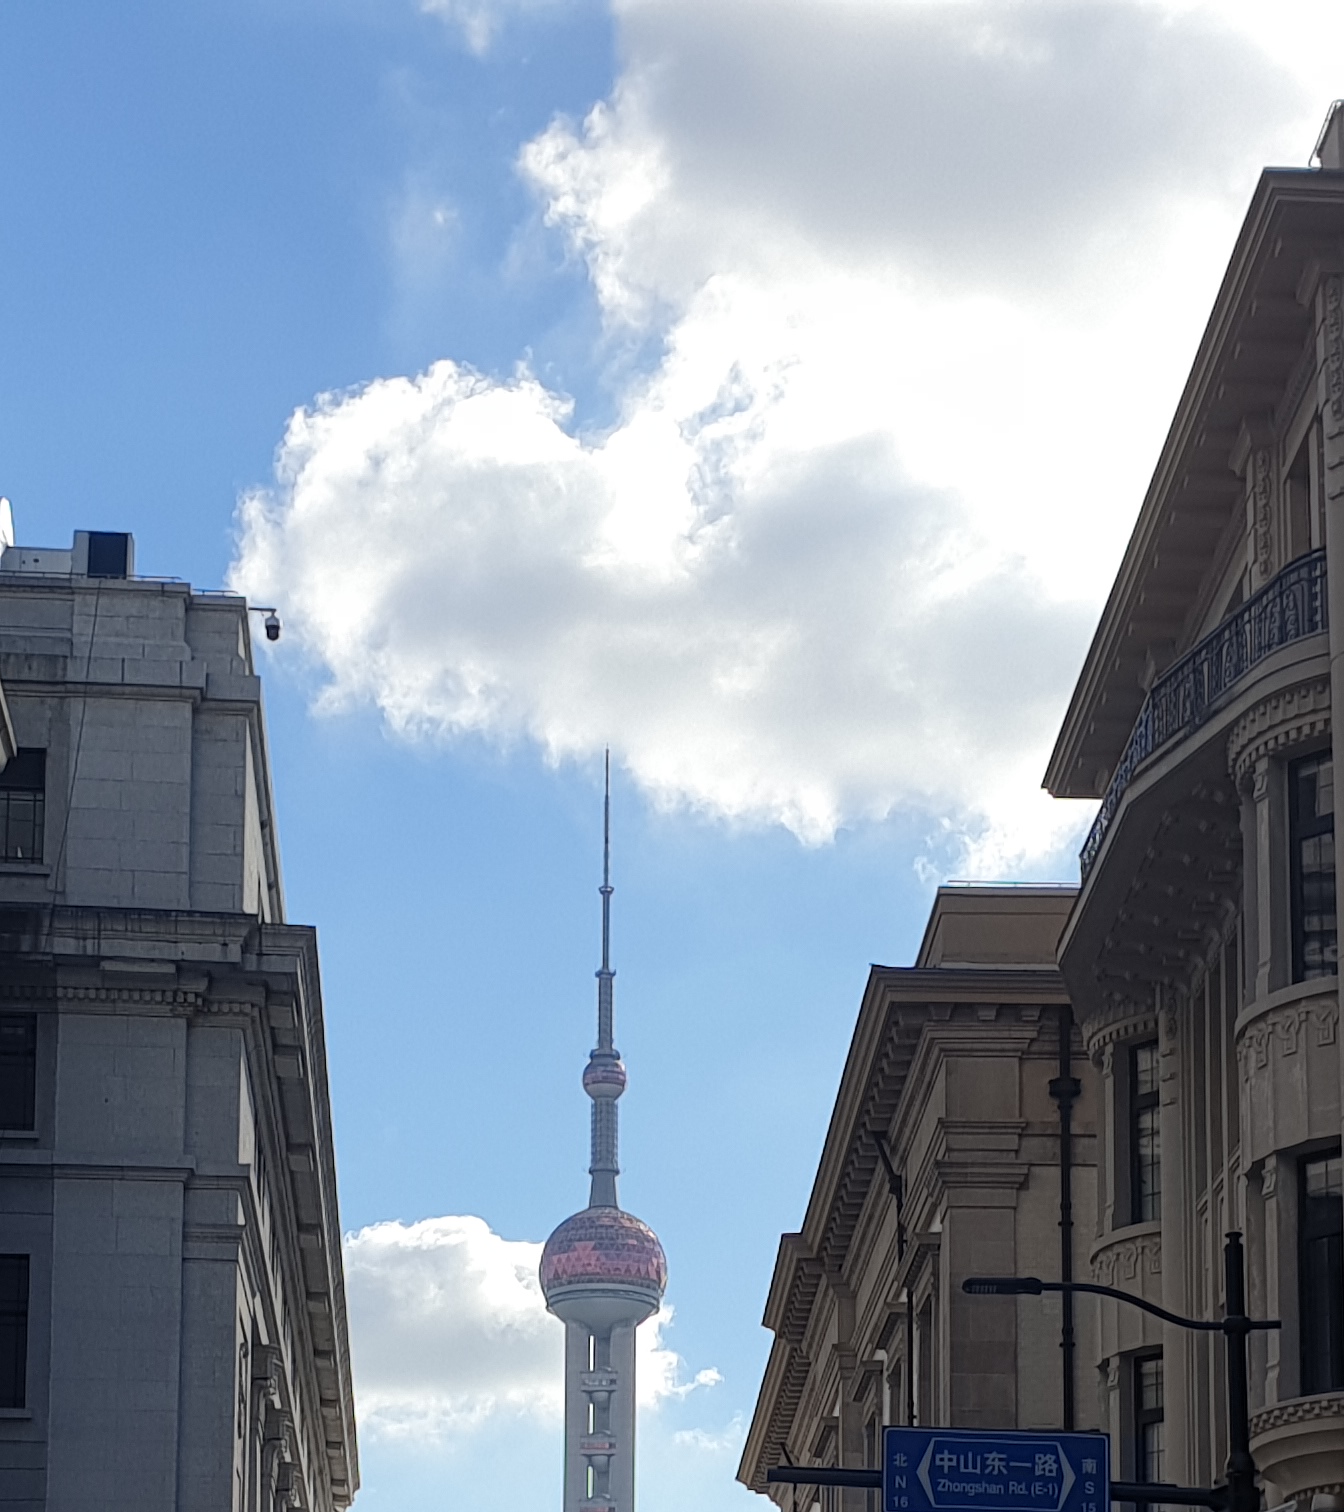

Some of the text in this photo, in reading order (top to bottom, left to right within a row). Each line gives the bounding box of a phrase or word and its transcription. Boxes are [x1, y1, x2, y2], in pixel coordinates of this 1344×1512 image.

[893, 1453, 908, 1467] 北
[934, 1449, 1058, 1477] 中山东一路
[1081, 1458, 1097, 1474] 南
[895, 1476, 907, 1488] N
[937, 1479, 1059, 1498] Zhongshan Rd. (E-1)
[1084, 1481, 1095, 1494] S
[892, 1496, 908, 1508] 16
